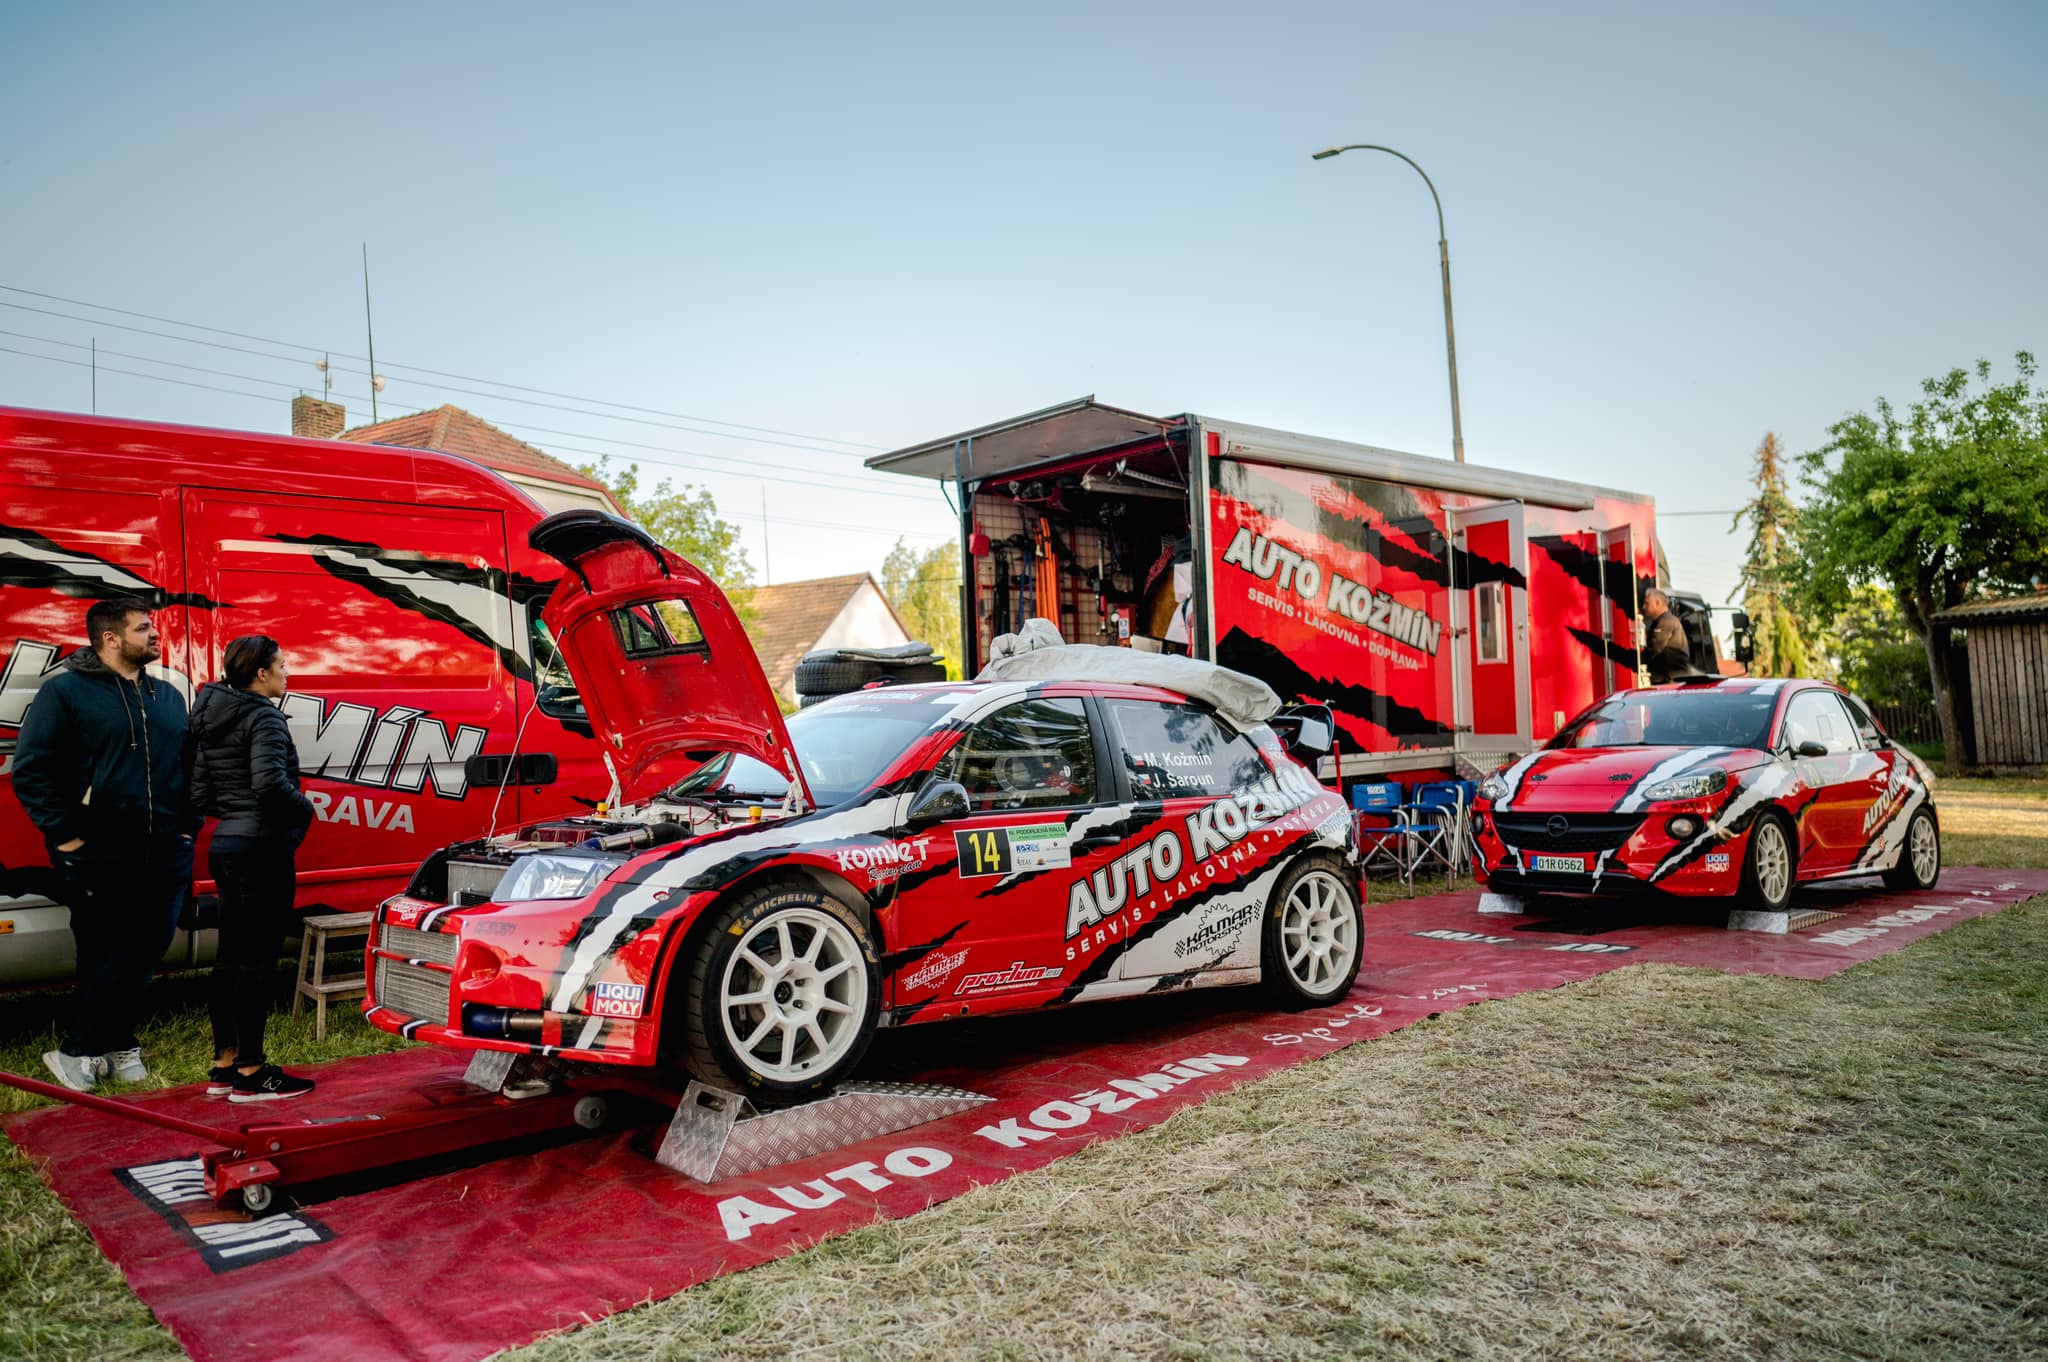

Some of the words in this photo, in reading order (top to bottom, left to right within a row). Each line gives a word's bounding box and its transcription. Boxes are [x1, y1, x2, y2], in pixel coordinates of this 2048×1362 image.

[1222, 525, 1321, 600] AUTO
[1327, 573, 1442, 657] KOŽMÍN
[1248, 587, 1294, 617] SERVIS
[1304, 613, 1360, 647] LAKOVNA
[1368, 640, 1419, 671] DOPRAVA
[1143, 752, 1162, 767] M.
[1153, 772, 1166, 788] J.
[1166, 769, 1215, 787] Šaroun
[304, 789, 416, 834] RAVA
[1862, 789, 1891, 835] AUTO
[968, 831, 1001, 873] 14
[1538, 858, 1556, 869] 01R
[1557, 859, 1583, 871] 0562
[1065, 830, 1183, 942] AUTO
[1066, 907, 1143, 961] SERVIS
[1164, 842, 1257, 903] LAKOVNA
[1274, 800, 1331, 837] DOPRAVA
[752, 893, 818, 917] MICHELIN
[1186, 905, 1253, 948] KALMAR
[1186, 915, 1253, 956] MOTORSPORT
[595, 999, 640, 1016] MOLY
[597, 983, 642, 1001] LIQUI
[716, 1146, 954, 1241] AUTO
[974, 1052, 1251, 1149] KOŽMÍN
